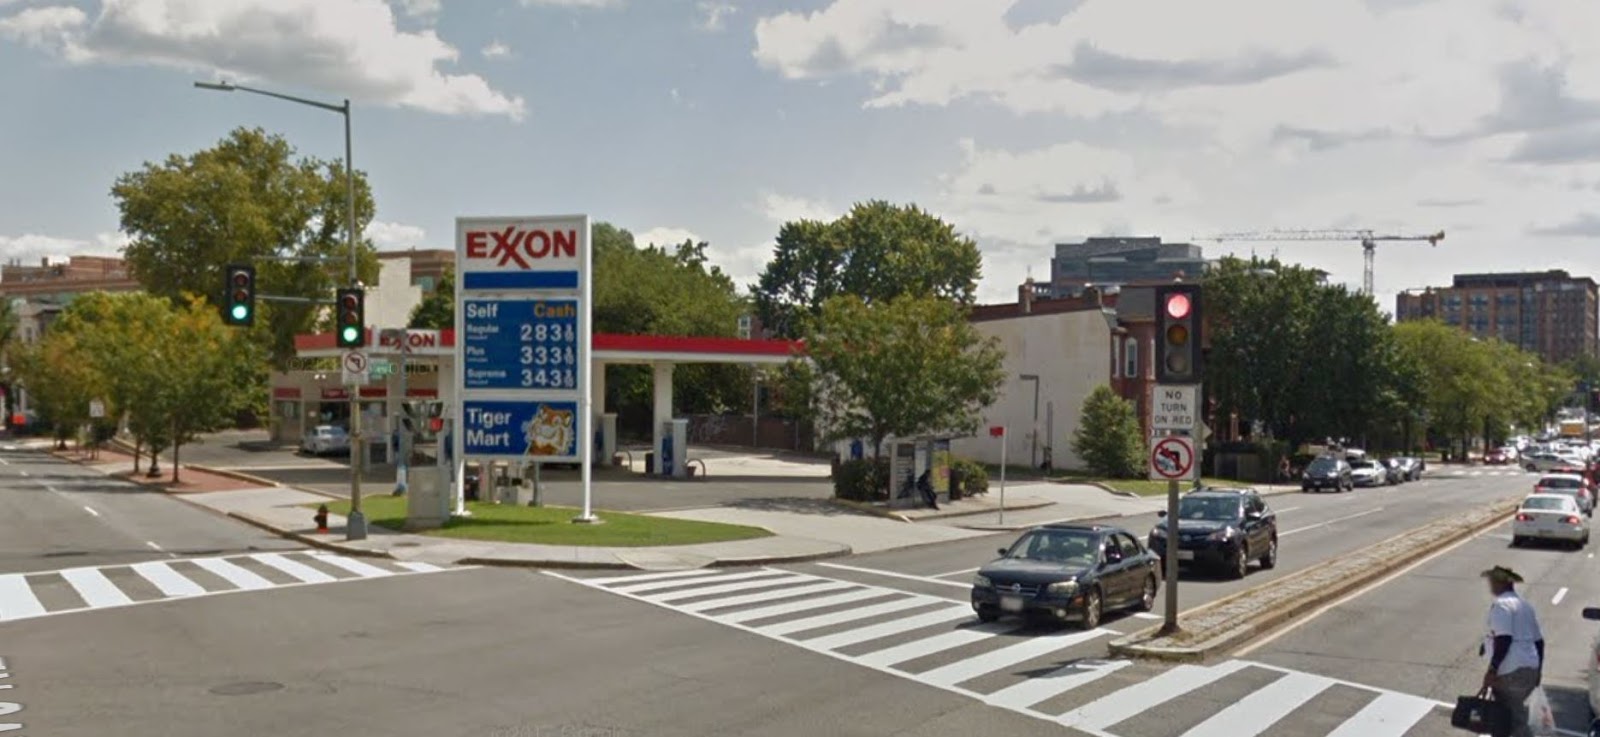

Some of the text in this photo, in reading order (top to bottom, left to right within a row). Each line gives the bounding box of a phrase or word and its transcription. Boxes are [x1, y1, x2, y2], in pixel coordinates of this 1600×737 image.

[466, 226, 576, 269] EXXON
[467, 302, 576, 318] Self Cash
[1166, 390, 1182, 400] NO
[1161, 403, 1187, 412] TURN
[466, 408, 512, 429] Tiger
[1154, 415, 1192, 425] ON RED
[466, 430, 510, 447] Mart
